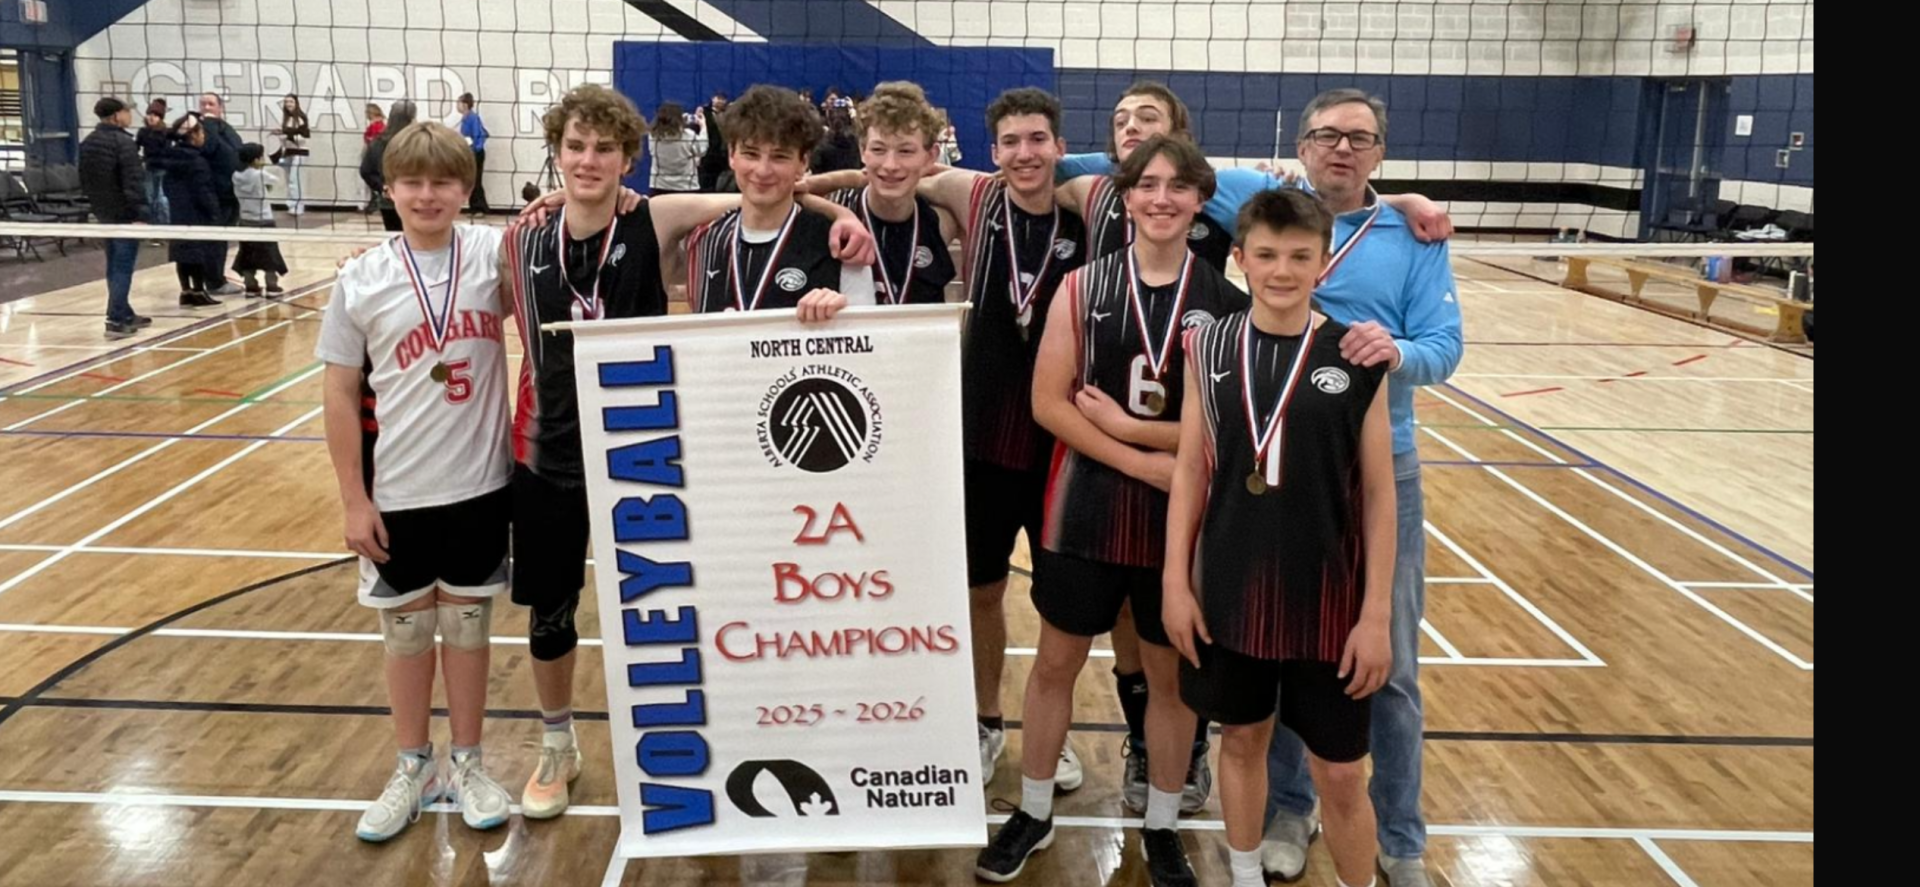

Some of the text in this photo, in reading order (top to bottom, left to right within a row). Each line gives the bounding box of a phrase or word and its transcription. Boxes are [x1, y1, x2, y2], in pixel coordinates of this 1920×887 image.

[750, 336, 874, 358] NORTH CENTRAL
[443, 358, 474, 405] 5
[756, 420, 783, 468] ALBERTA
[802, 364, 862, 388] ATHLETIC
[859, 387, 882, 463] ASSOCIATION
[793, 502, 865, 547] 2A
[597, 344, 715, 836] VOLLEYBALL
[755, 704, 825, 726] 2025
[856, 696, 926, 723] 2026
[850, 765, 969, 788] Canadian
[866, 786, 956, 808] Natural
